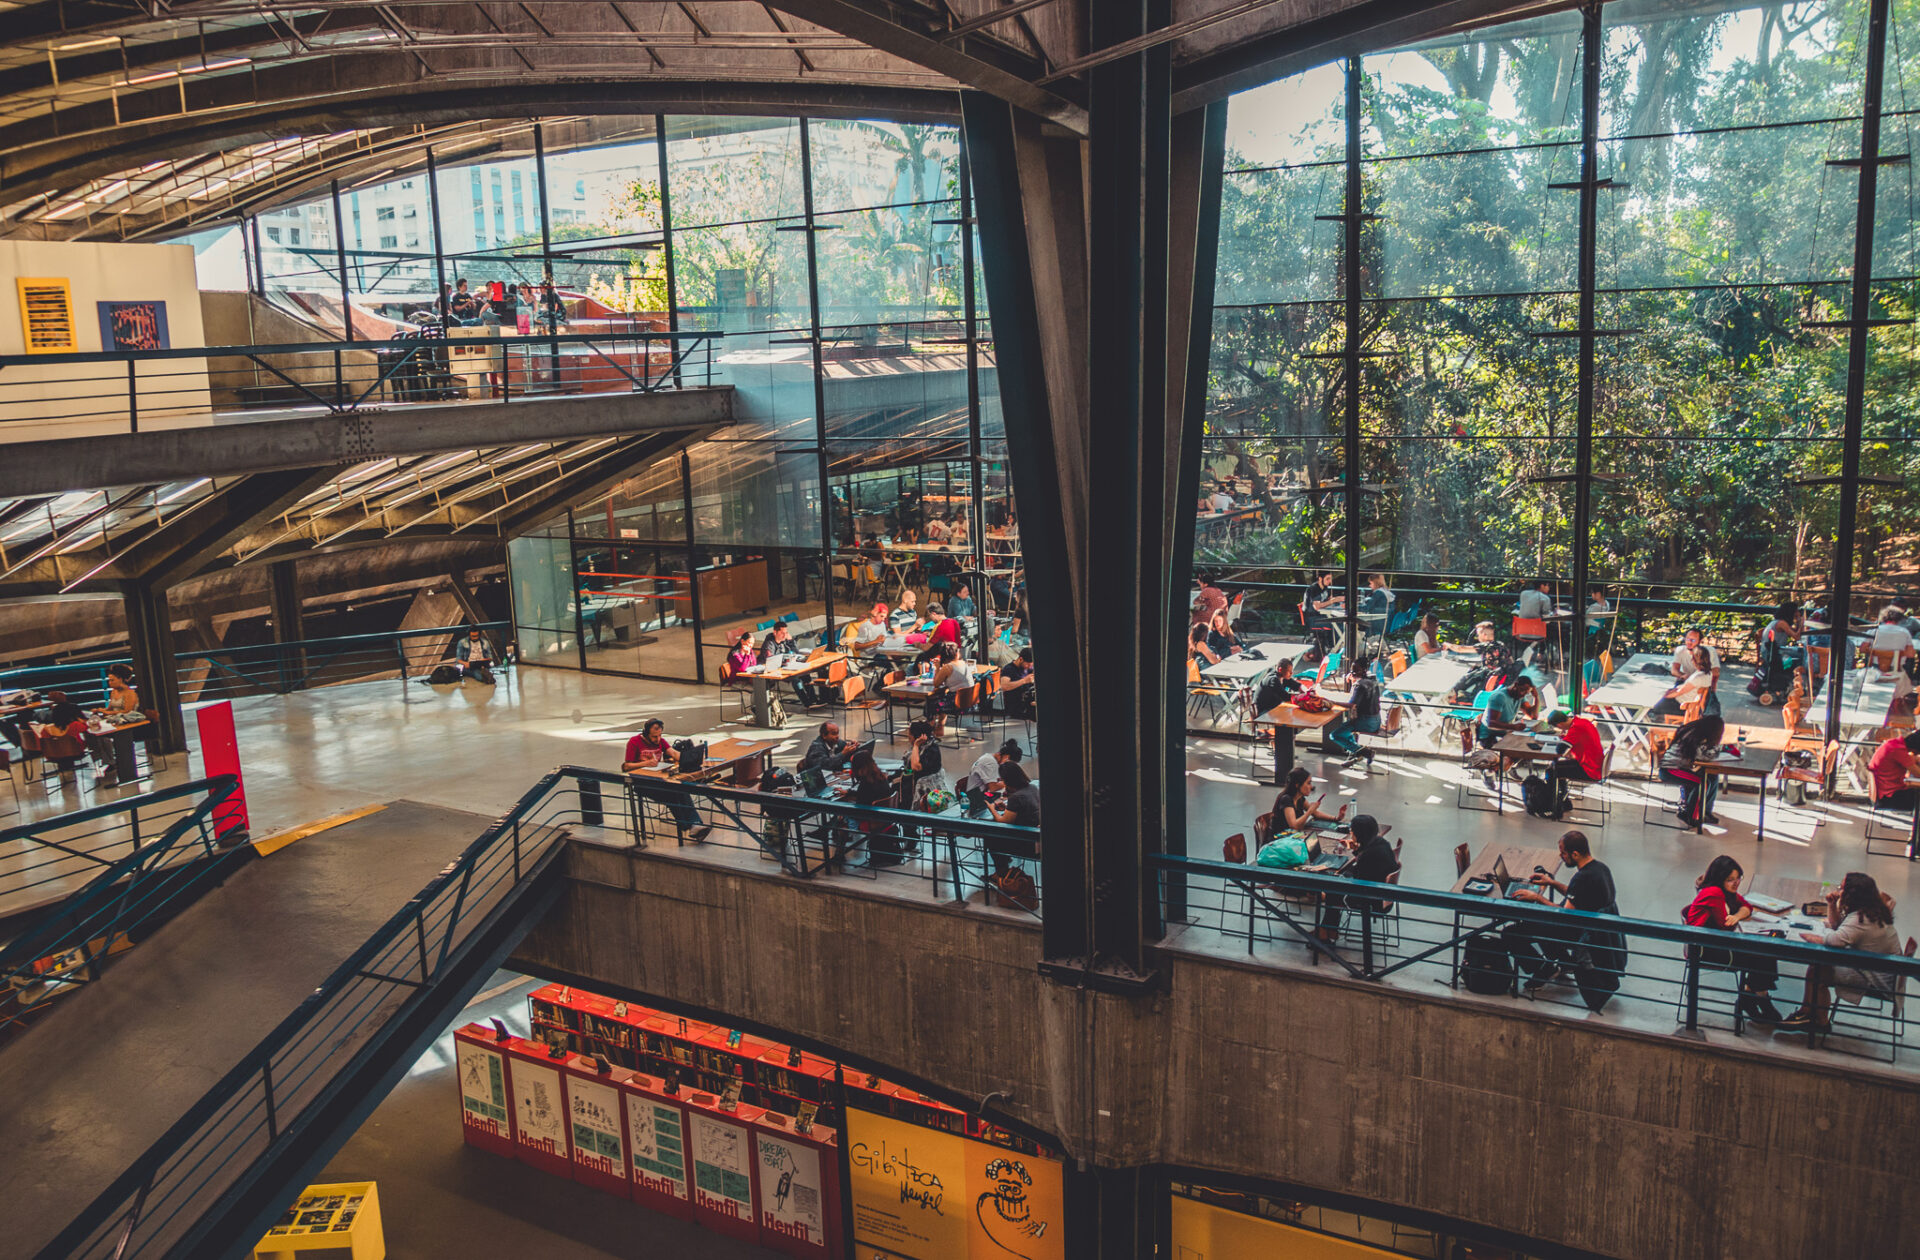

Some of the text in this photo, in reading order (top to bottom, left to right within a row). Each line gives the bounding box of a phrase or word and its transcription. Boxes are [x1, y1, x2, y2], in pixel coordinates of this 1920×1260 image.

[464, 1110, 498, 1136] Henfil
[518, 1129, 555, 1155] Henfil
[759, 1140, 787, 1159] DIRETAS
[574, 1148, 612, 1174] Henfil
[633, 1169, 674, 1196] Henfil
[696, 1189, 739, 1217] Henfil
[763, 1211, 809, 1241] Henfil
